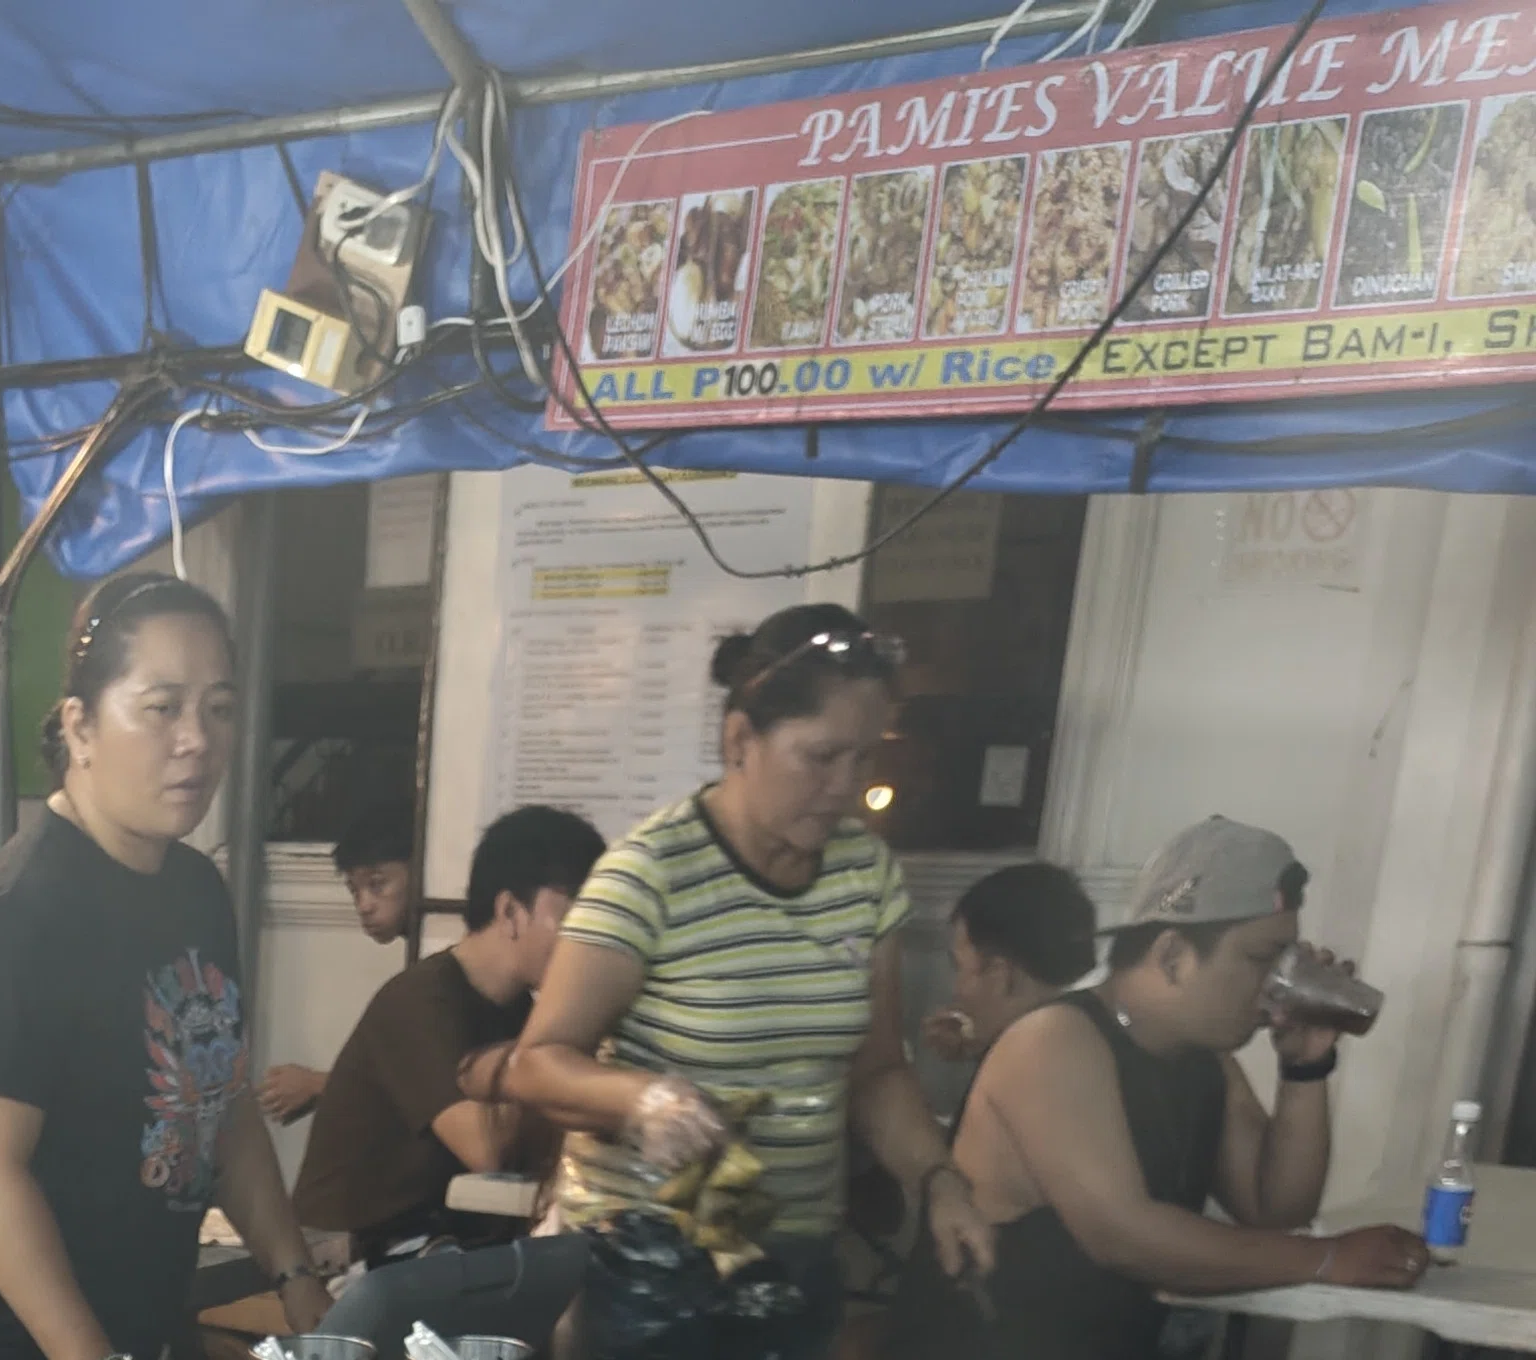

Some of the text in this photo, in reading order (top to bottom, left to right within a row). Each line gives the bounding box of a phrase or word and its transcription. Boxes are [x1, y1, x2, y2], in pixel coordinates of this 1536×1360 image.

[797, 12, 1536, 167] PAMIES VALUE ME
[590, 367, 674, 401] ALL
[691, 358, 851, 397] P100.00
[868, 353, 925, 388] w/
[940, 348, 1057, 384] Rice
[1101, 333, 1280, 374] EXCEPT
